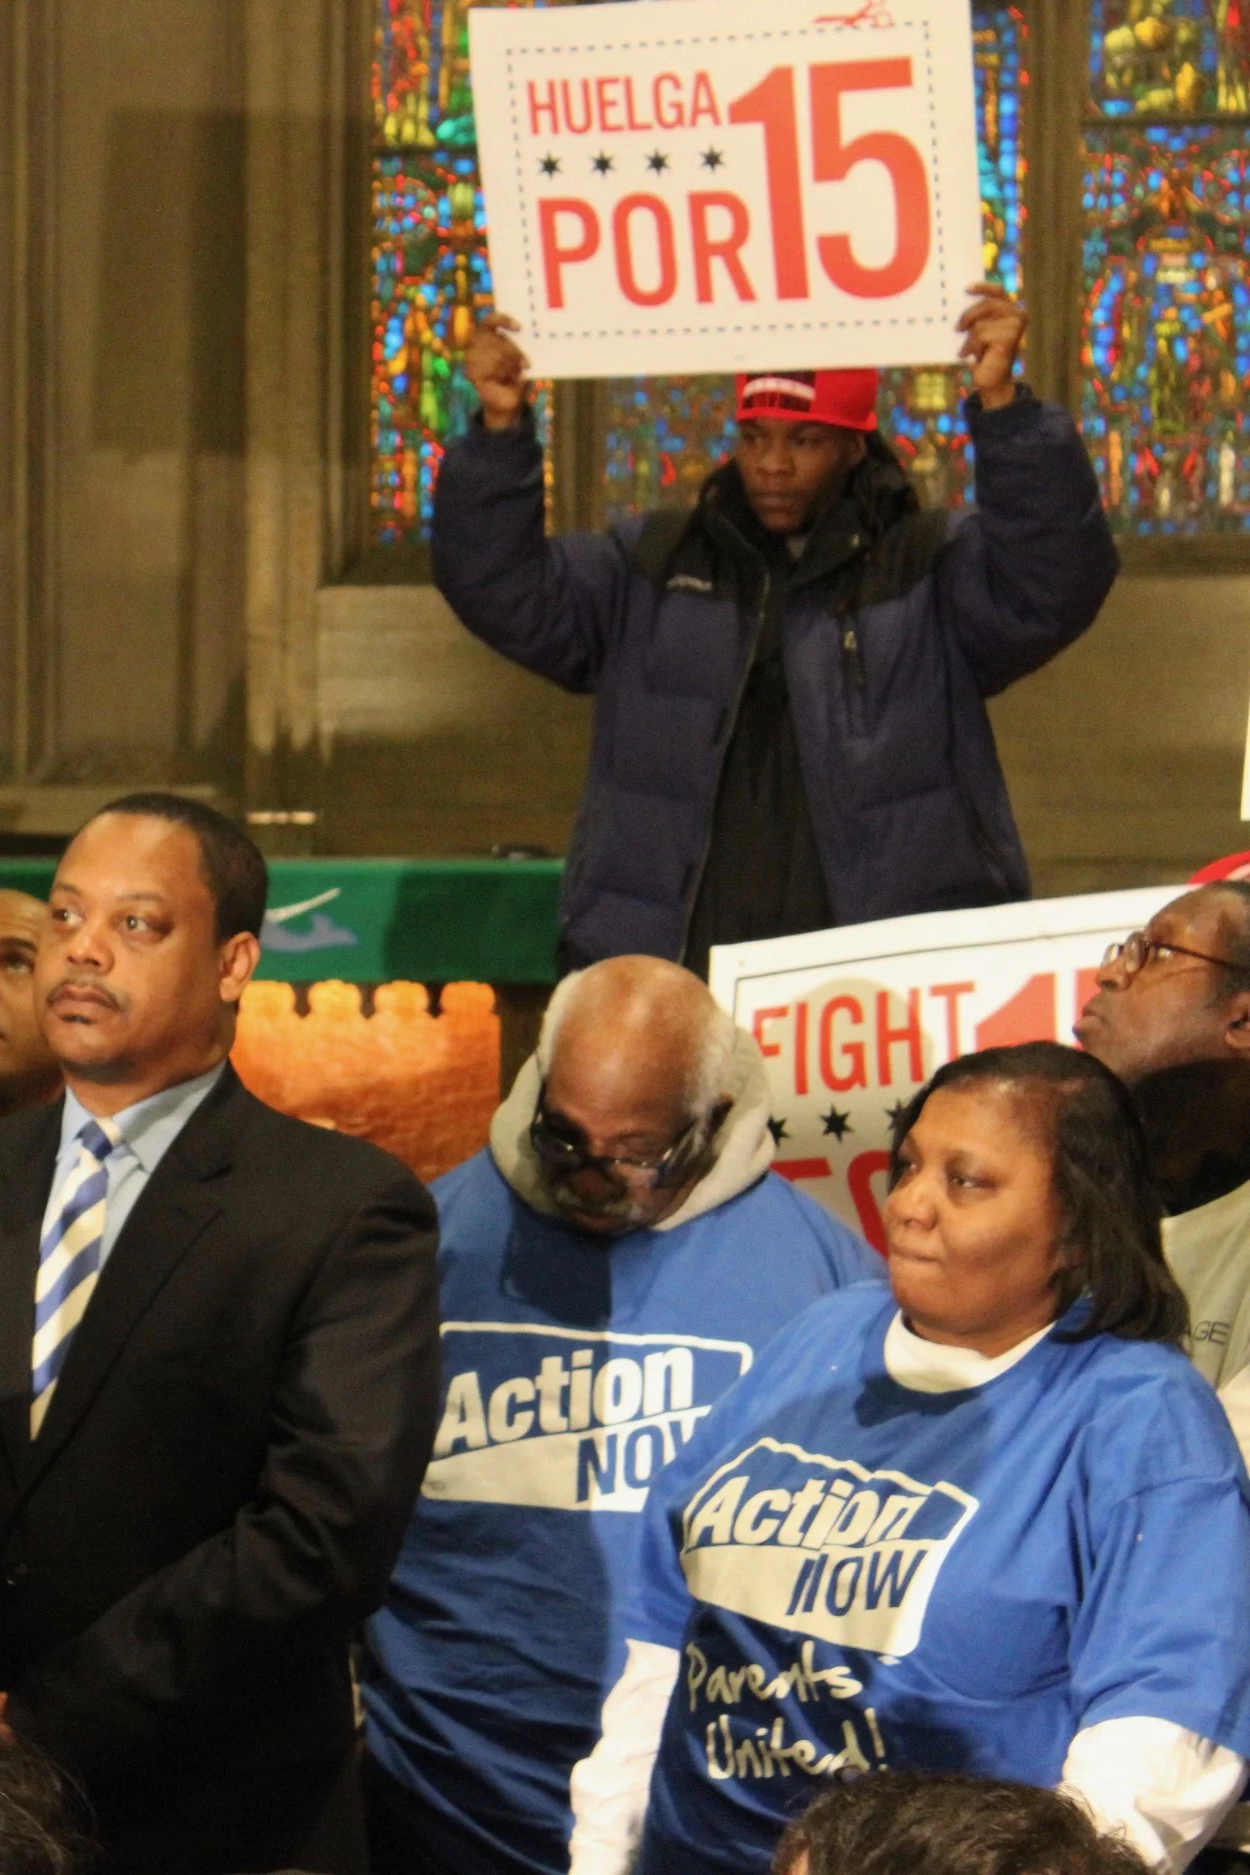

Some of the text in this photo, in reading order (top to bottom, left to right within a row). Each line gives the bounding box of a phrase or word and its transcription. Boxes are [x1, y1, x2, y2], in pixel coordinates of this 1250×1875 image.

[526, 69, 721, 135] HUELGA
[537, 55, 931, 310] POR 15
[752, 980, 976, 1096] FIGHT
[433, 1346, 693, 1459] Action
[688, 1475, 927, 1551] Action
[785, 1548, 930, 1617] NOW
[686, 1639, 863, 1712] Parents
